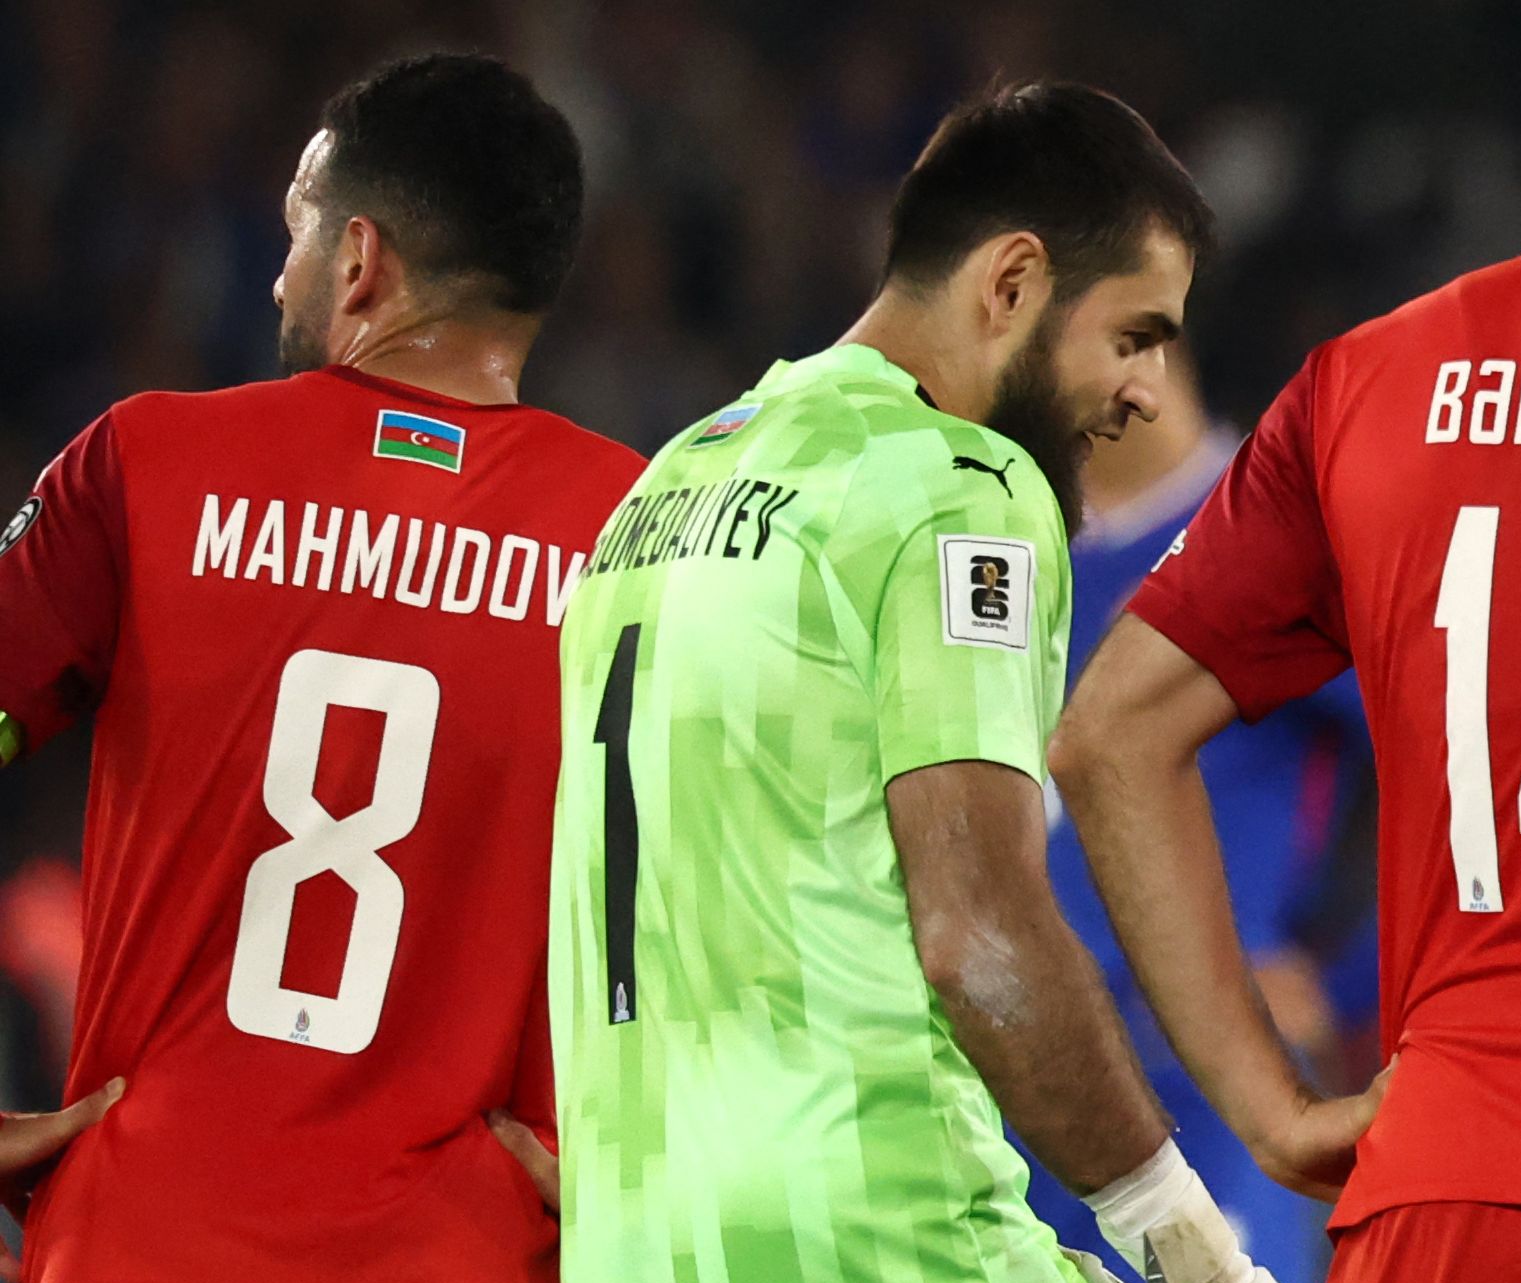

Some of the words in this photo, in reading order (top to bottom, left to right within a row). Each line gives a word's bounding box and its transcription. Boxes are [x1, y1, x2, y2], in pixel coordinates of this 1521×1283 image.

[192, 494, 587, 626] MAHMUDOV
[982, 606, 1001, 616] FIFA
[226, 648, 441, 1055] 8
[593, 622, 642, 1026] 1
